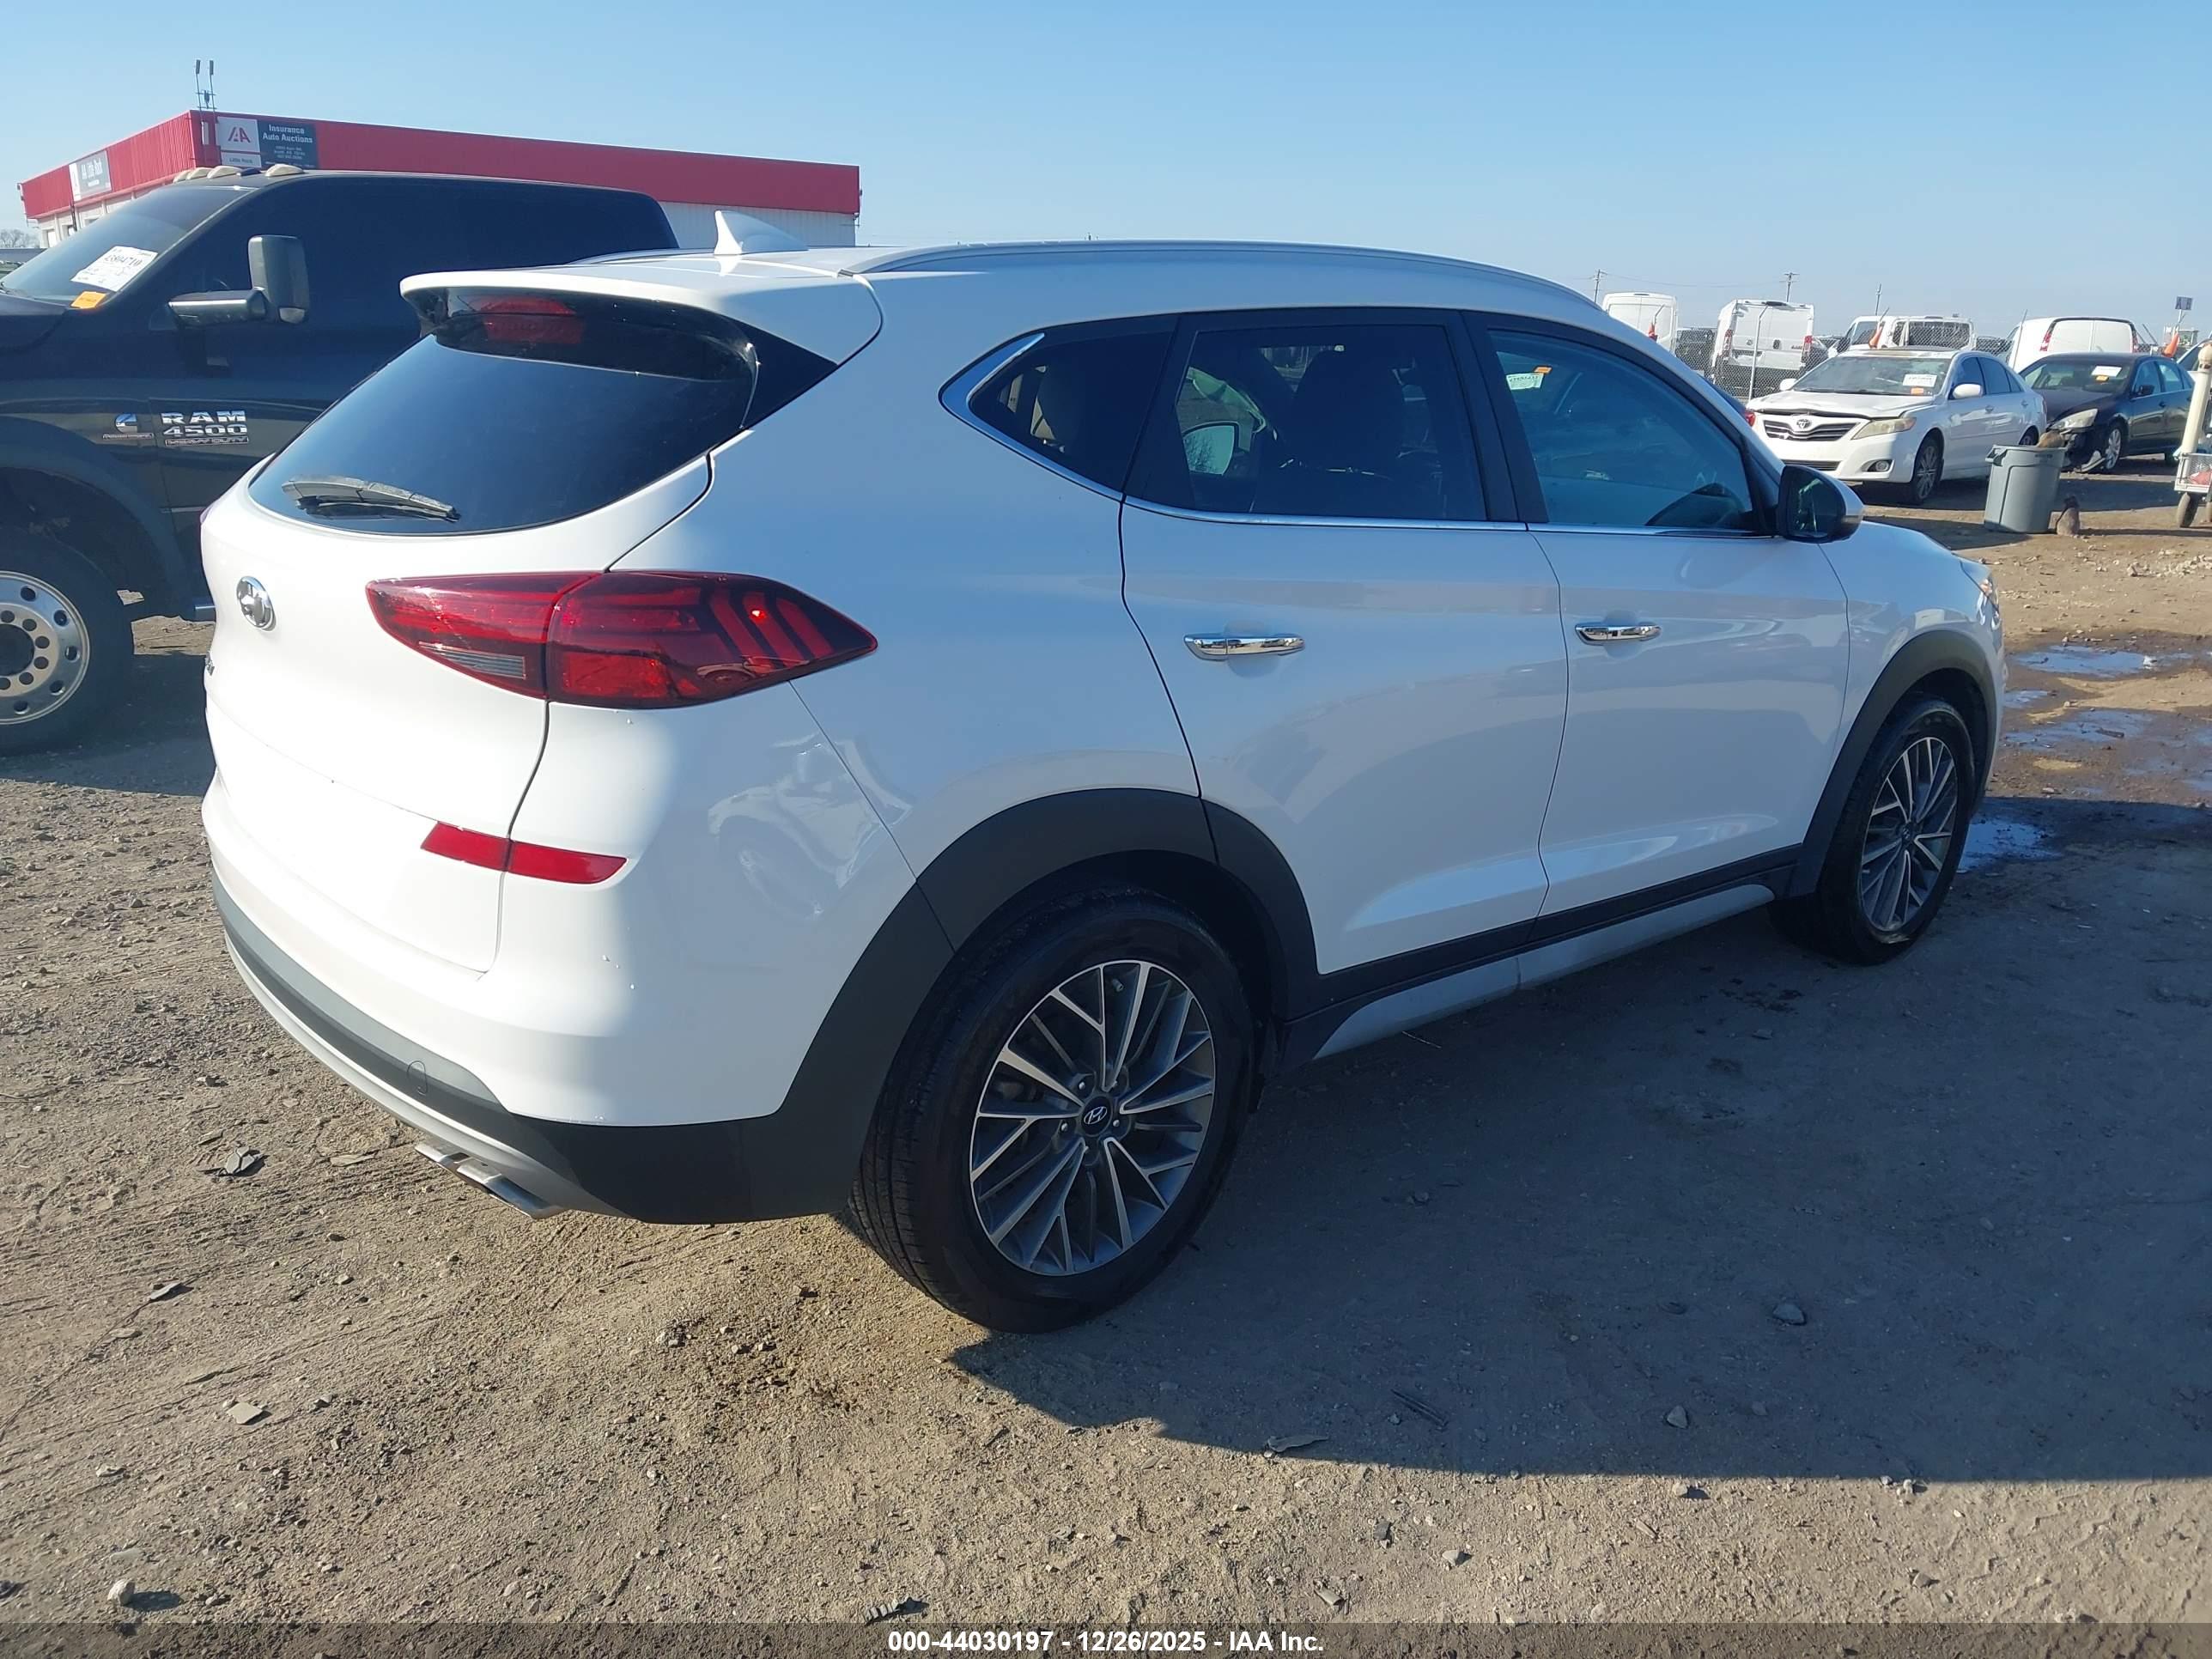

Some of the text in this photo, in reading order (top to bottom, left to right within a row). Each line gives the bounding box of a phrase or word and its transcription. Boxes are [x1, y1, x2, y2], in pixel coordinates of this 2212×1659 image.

[269, 124, 305, 134] Insurance
[263, 131, 313, 143] Auto Auctions
[161, 410, 246, 424] RAM
[163, 423, 248, 437] 4500
